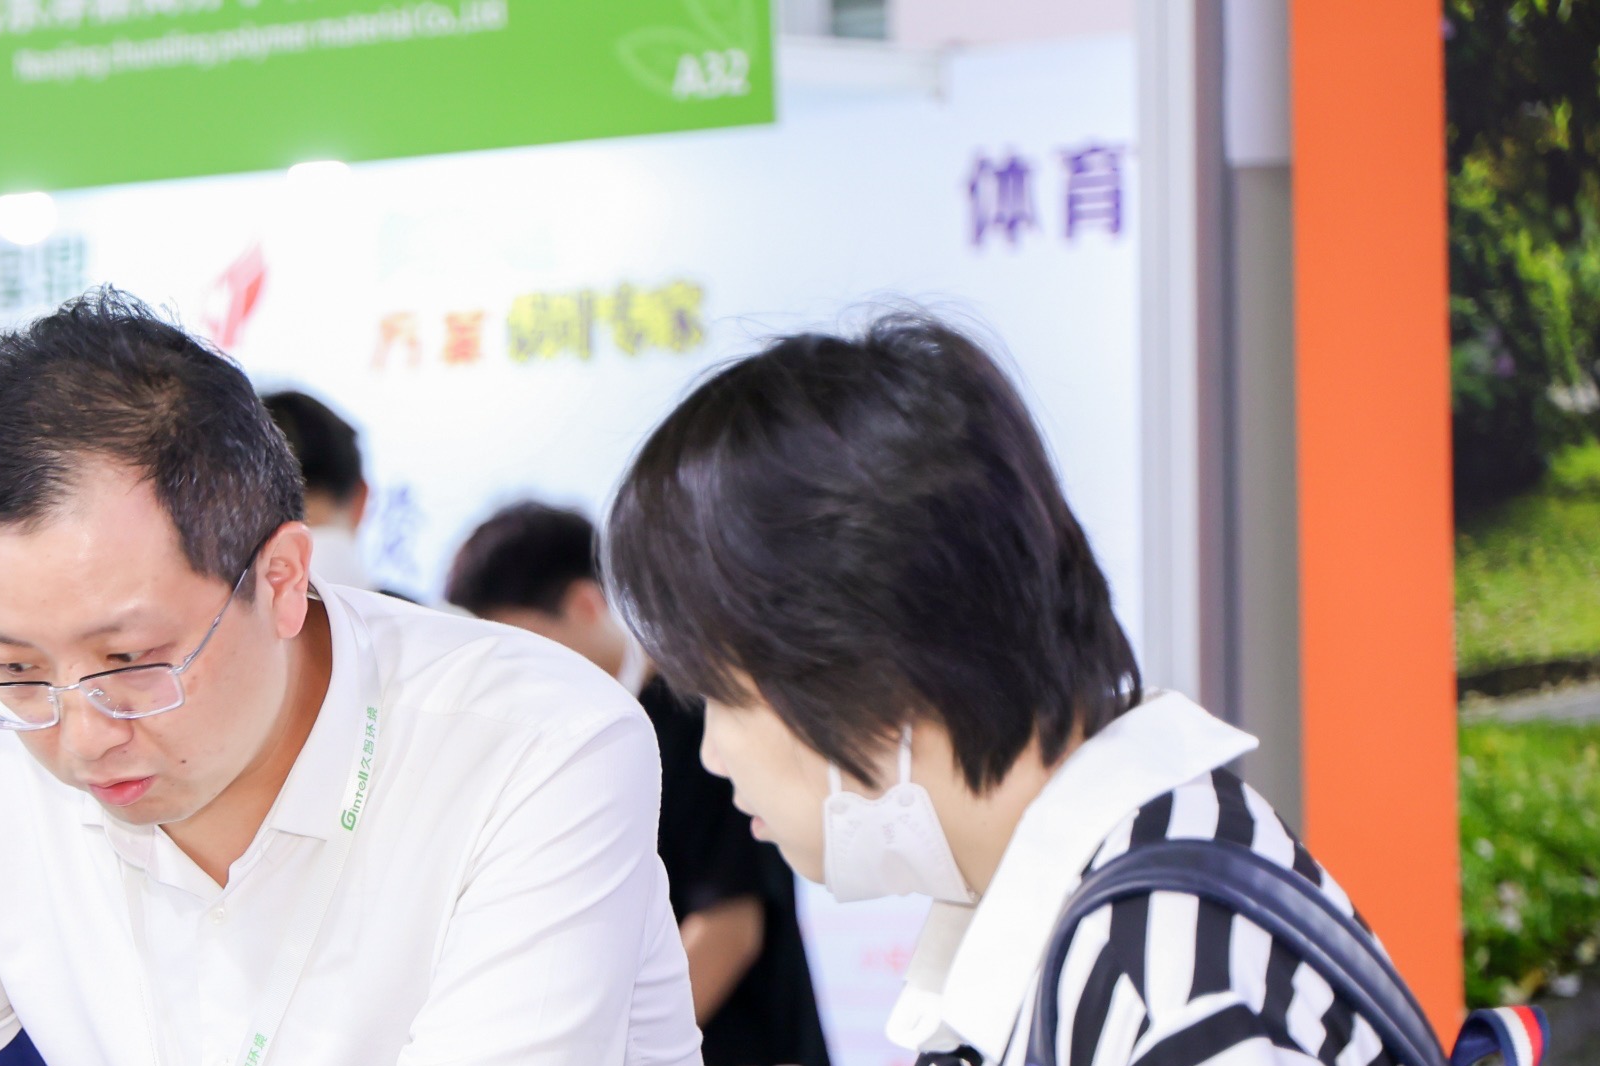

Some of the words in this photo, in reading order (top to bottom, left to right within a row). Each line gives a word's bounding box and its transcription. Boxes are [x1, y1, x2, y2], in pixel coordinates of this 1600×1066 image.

[317, 8, 412, 48] material
[671, 48, 750, 101] A32
[967, 146, 1124, 245] 体育
